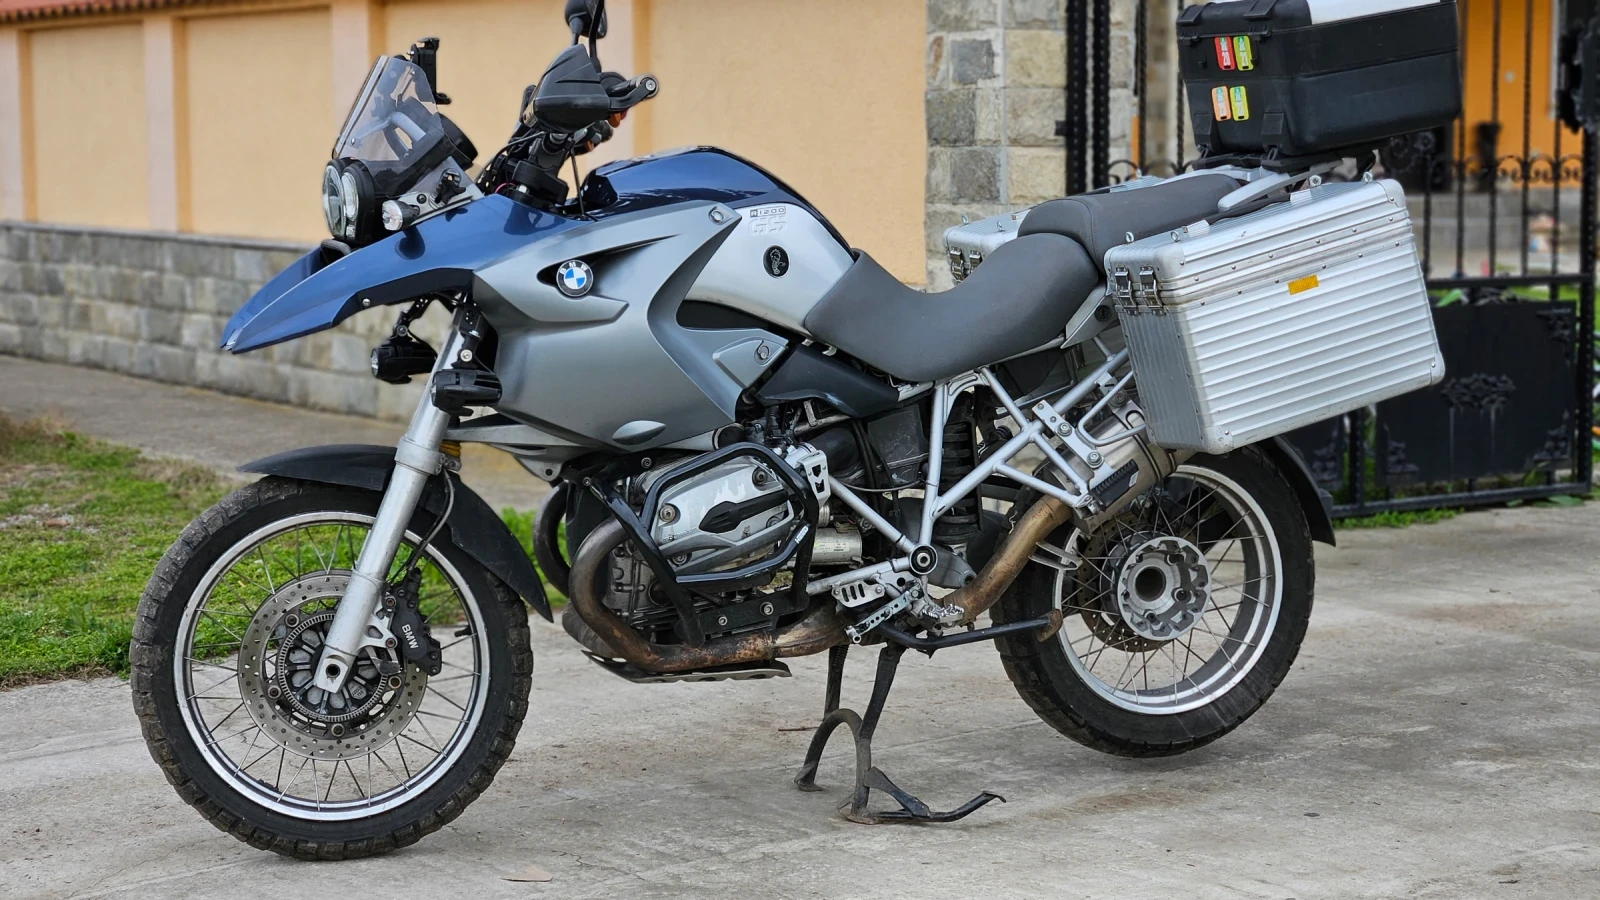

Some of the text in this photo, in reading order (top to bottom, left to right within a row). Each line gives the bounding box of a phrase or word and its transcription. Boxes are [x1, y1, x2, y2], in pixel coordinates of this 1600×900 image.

[748, 215, 787, 234] GS
[560, 261, 589, 275] BMW
[401, 624, 419, 649] BMW
